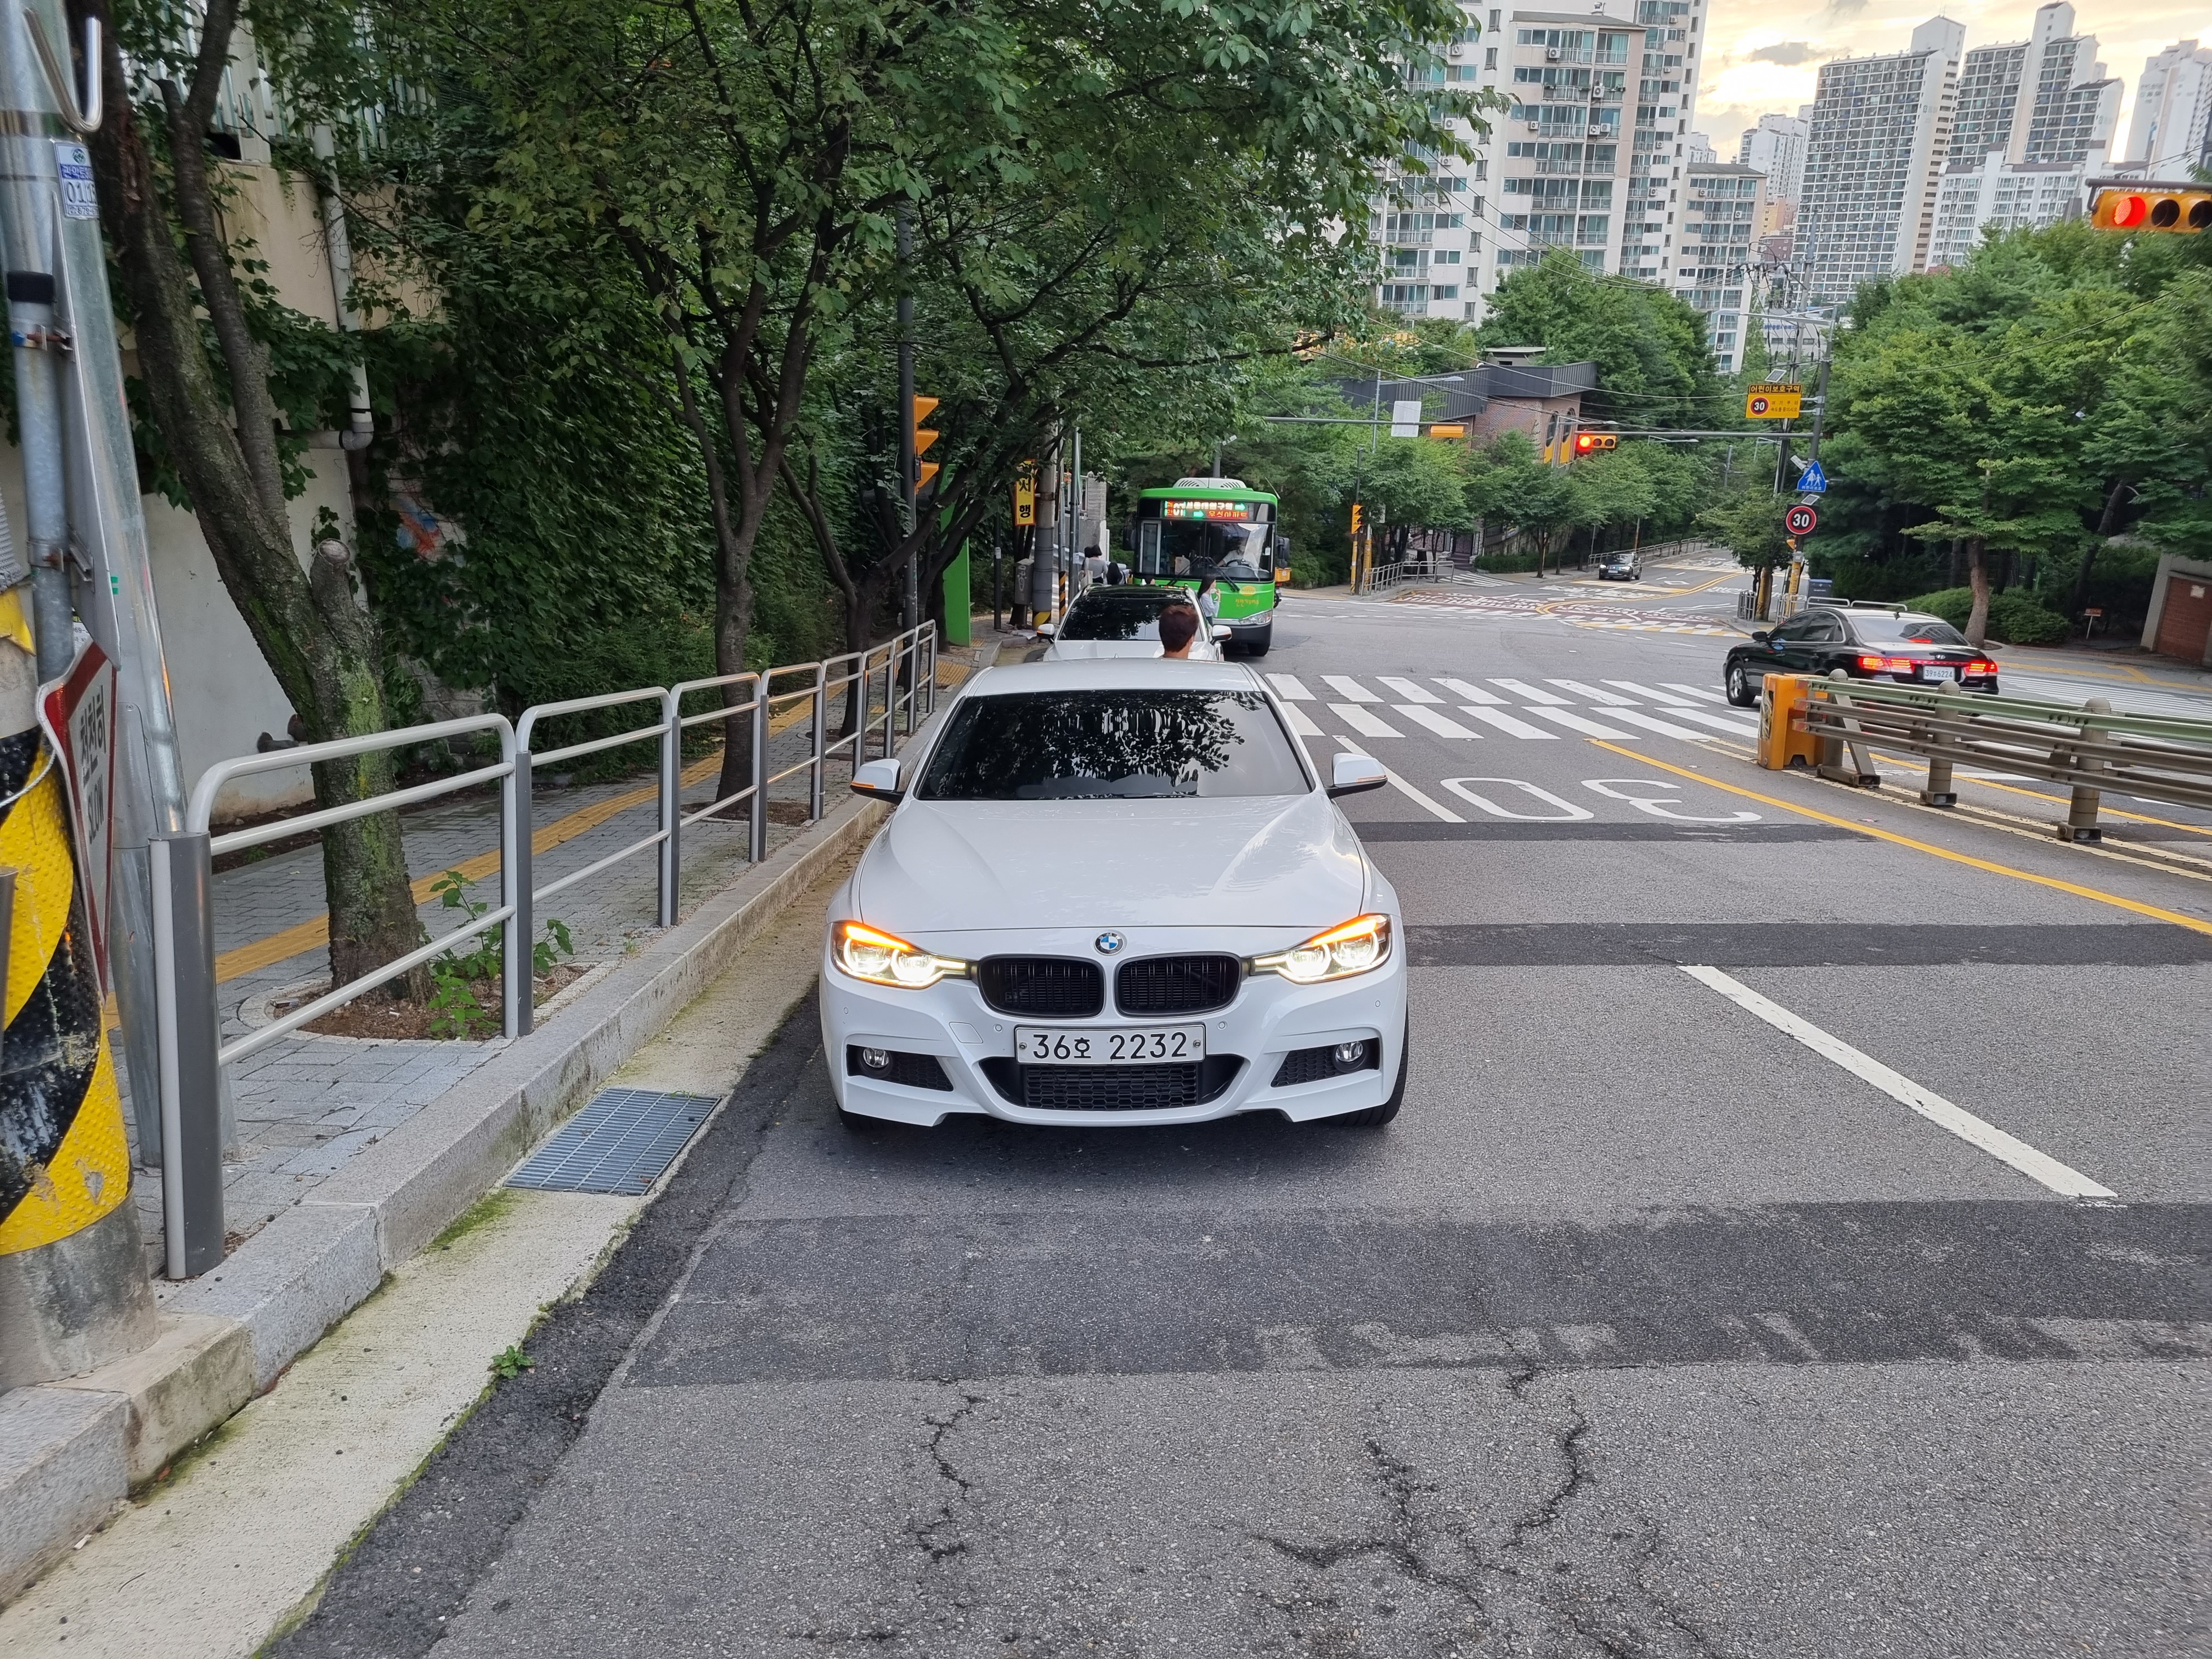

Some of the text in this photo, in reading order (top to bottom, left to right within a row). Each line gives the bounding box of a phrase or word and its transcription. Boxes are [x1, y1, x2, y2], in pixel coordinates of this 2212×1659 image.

[1751, 385, 1799, 393] 어린이보호구역
[1754, 402, 1765, 410] 30
[1792, 513, 1809, 527] 30
[80, 684, 107, 790] 천천히
[88, 774, 104, 845] SLOW
[1033, 1032, 1187, 1060] 36호 2232
